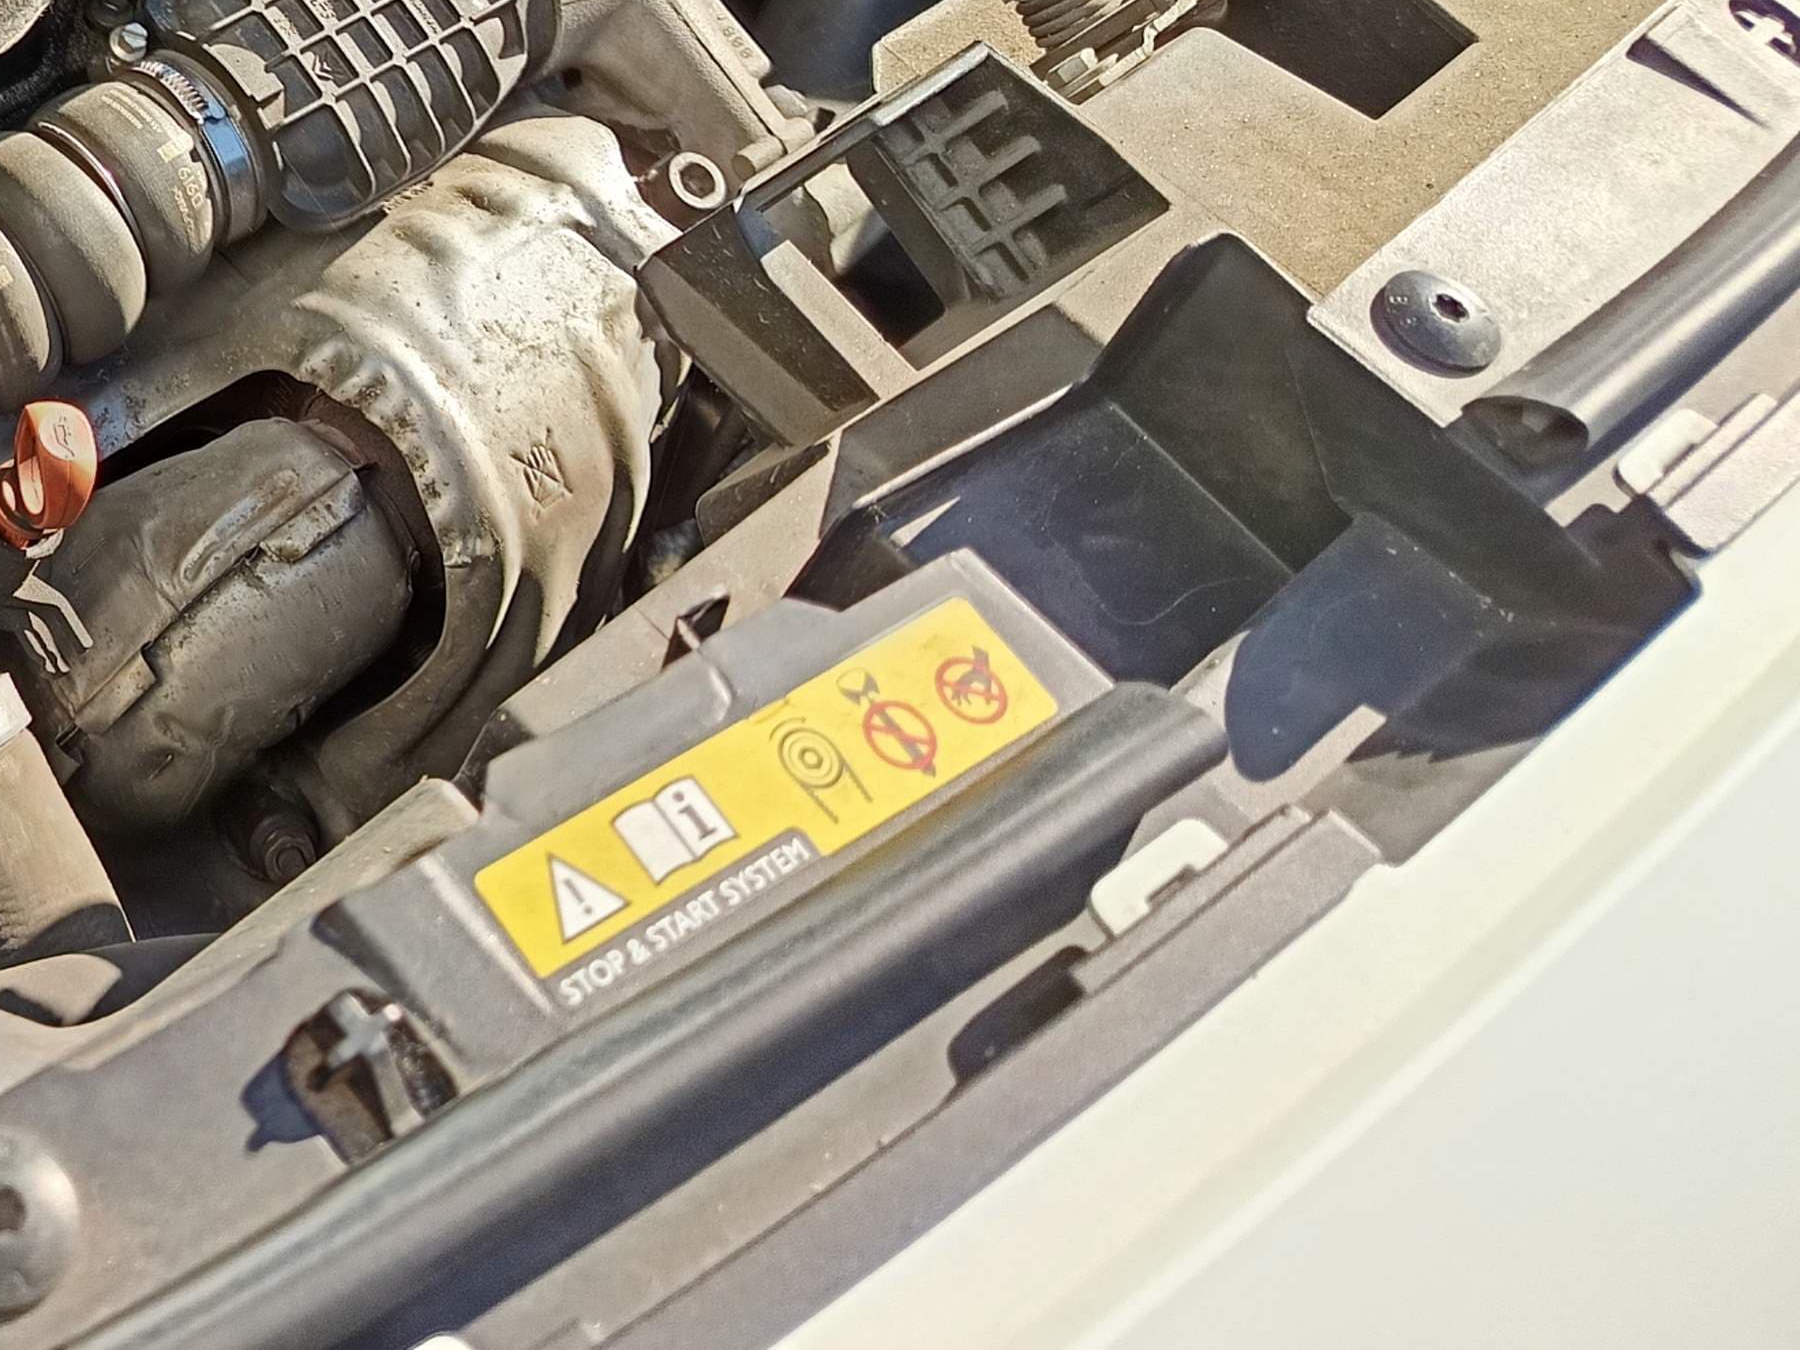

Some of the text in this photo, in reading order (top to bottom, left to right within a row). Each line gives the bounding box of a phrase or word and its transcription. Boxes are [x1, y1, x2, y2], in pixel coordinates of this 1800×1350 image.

[559, 837, 810, 1006] STOP & START SYSTEM
